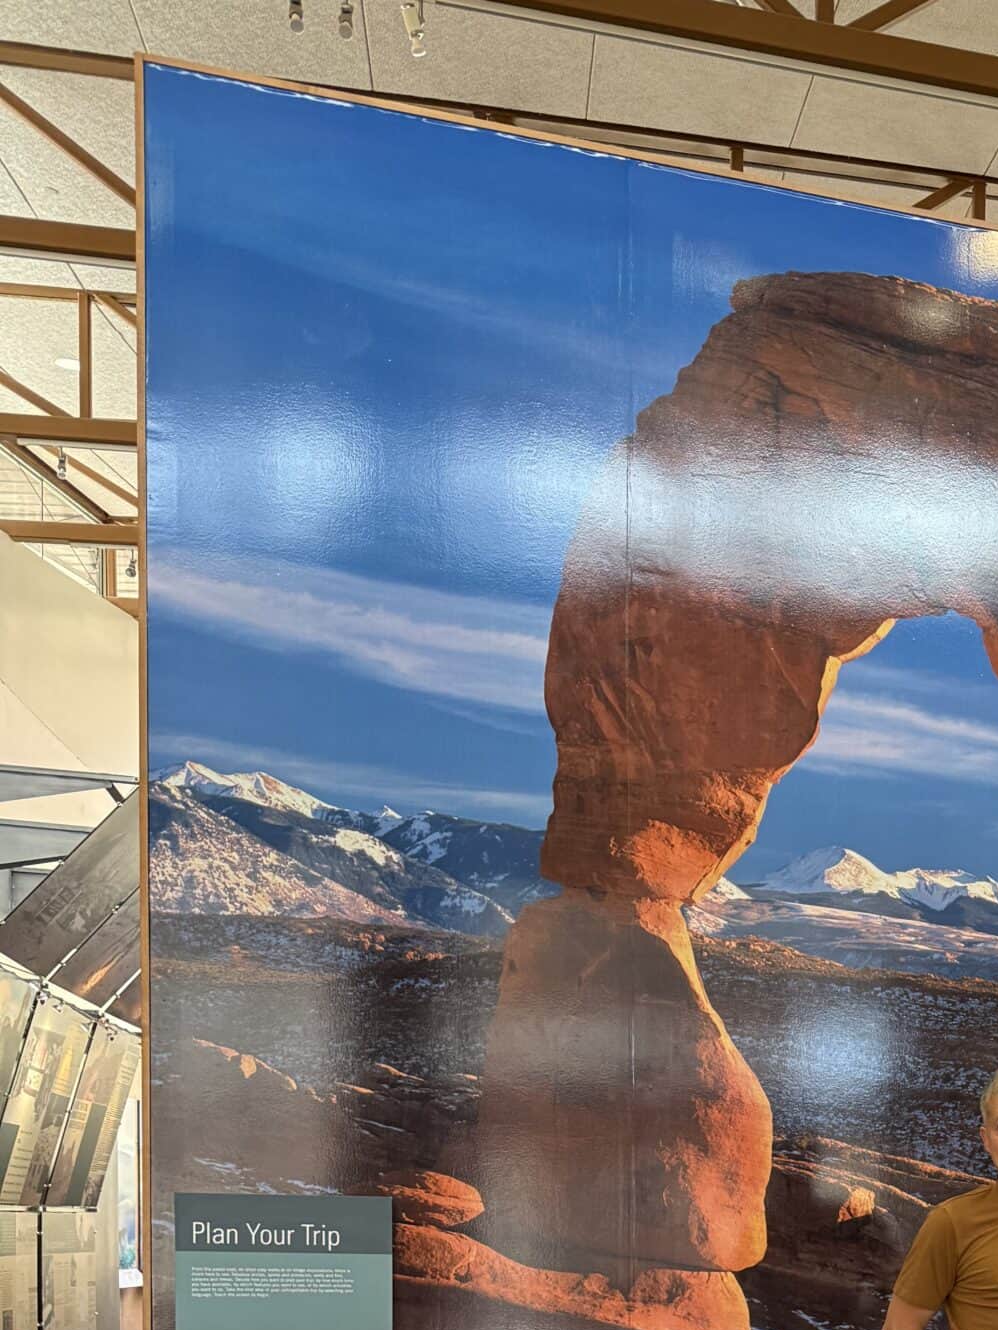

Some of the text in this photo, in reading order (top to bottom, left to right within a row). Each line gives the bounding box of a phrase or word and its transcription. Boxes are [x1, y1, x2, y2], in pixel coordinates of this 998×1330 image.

[191, 1221, 341, 1252] Plan Your Trip
